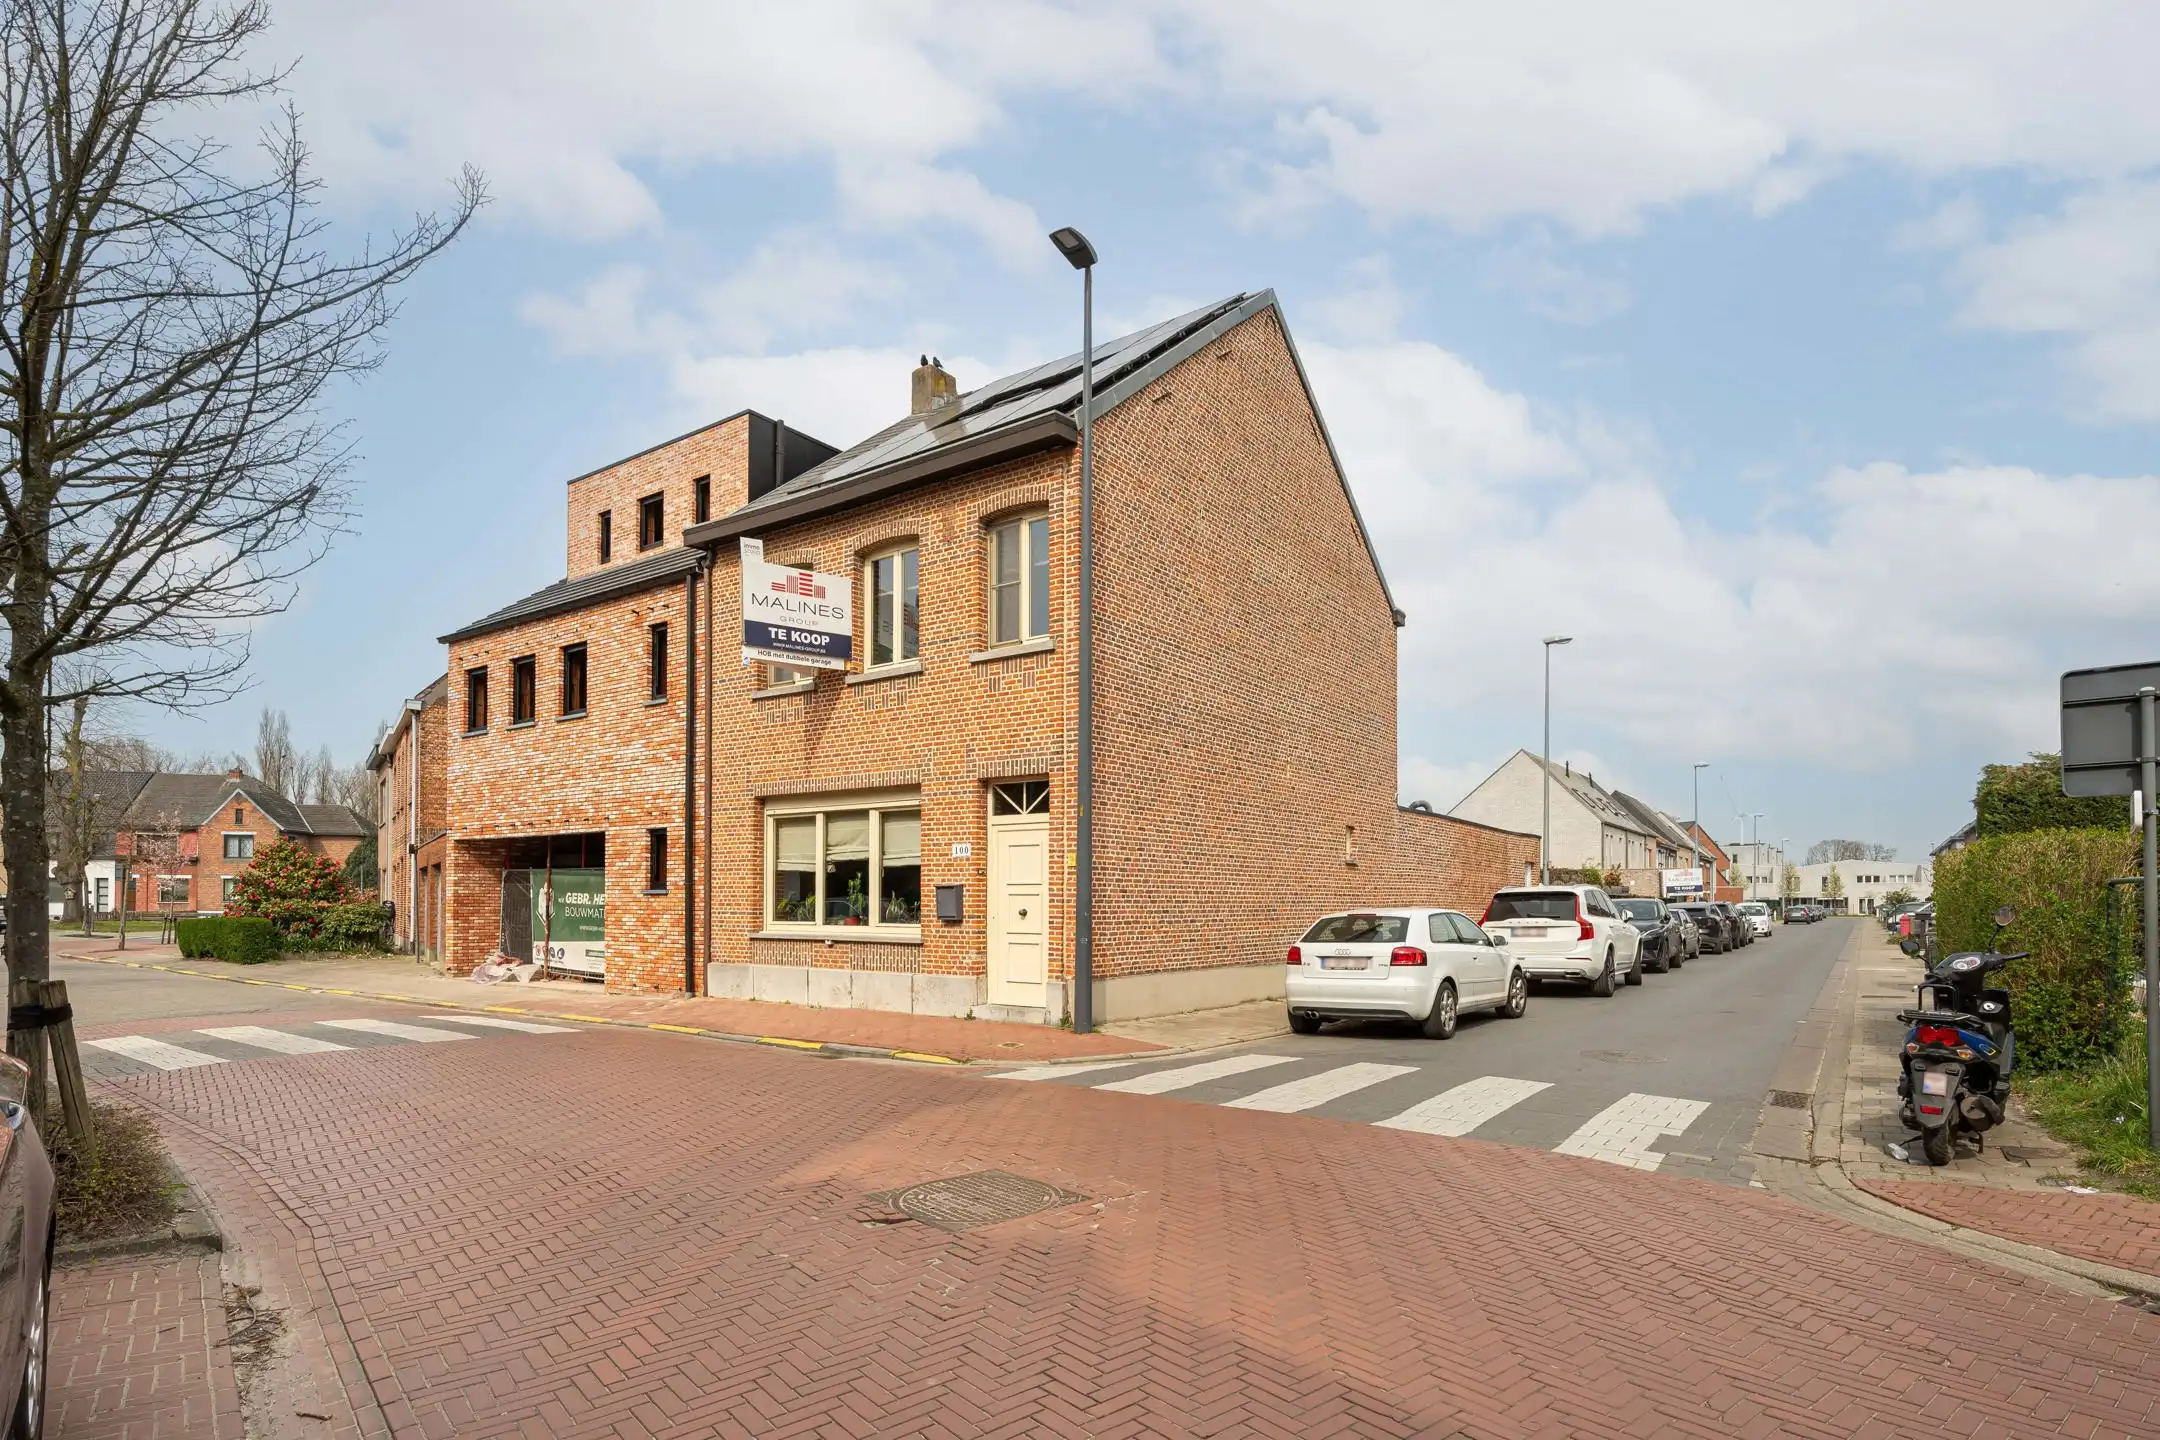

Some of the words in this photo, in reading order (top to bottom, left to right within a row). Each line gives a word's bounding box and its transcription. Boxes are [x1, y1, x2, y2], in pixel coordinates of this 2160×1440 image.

[751, 593, 844, 619] MALINES
[779, 616, 819, 627] GROUP
[768, 627, 787, 641] TE
[791, 630, 830, 646] KOOP
[757, 649, 772, 657] HOB
[786, 654, 811, 663] dubbele
[811, 658, 832, 667] garage
[955, 846, 969, 854] 100
[565, 892, 591, 905] GEBR.
